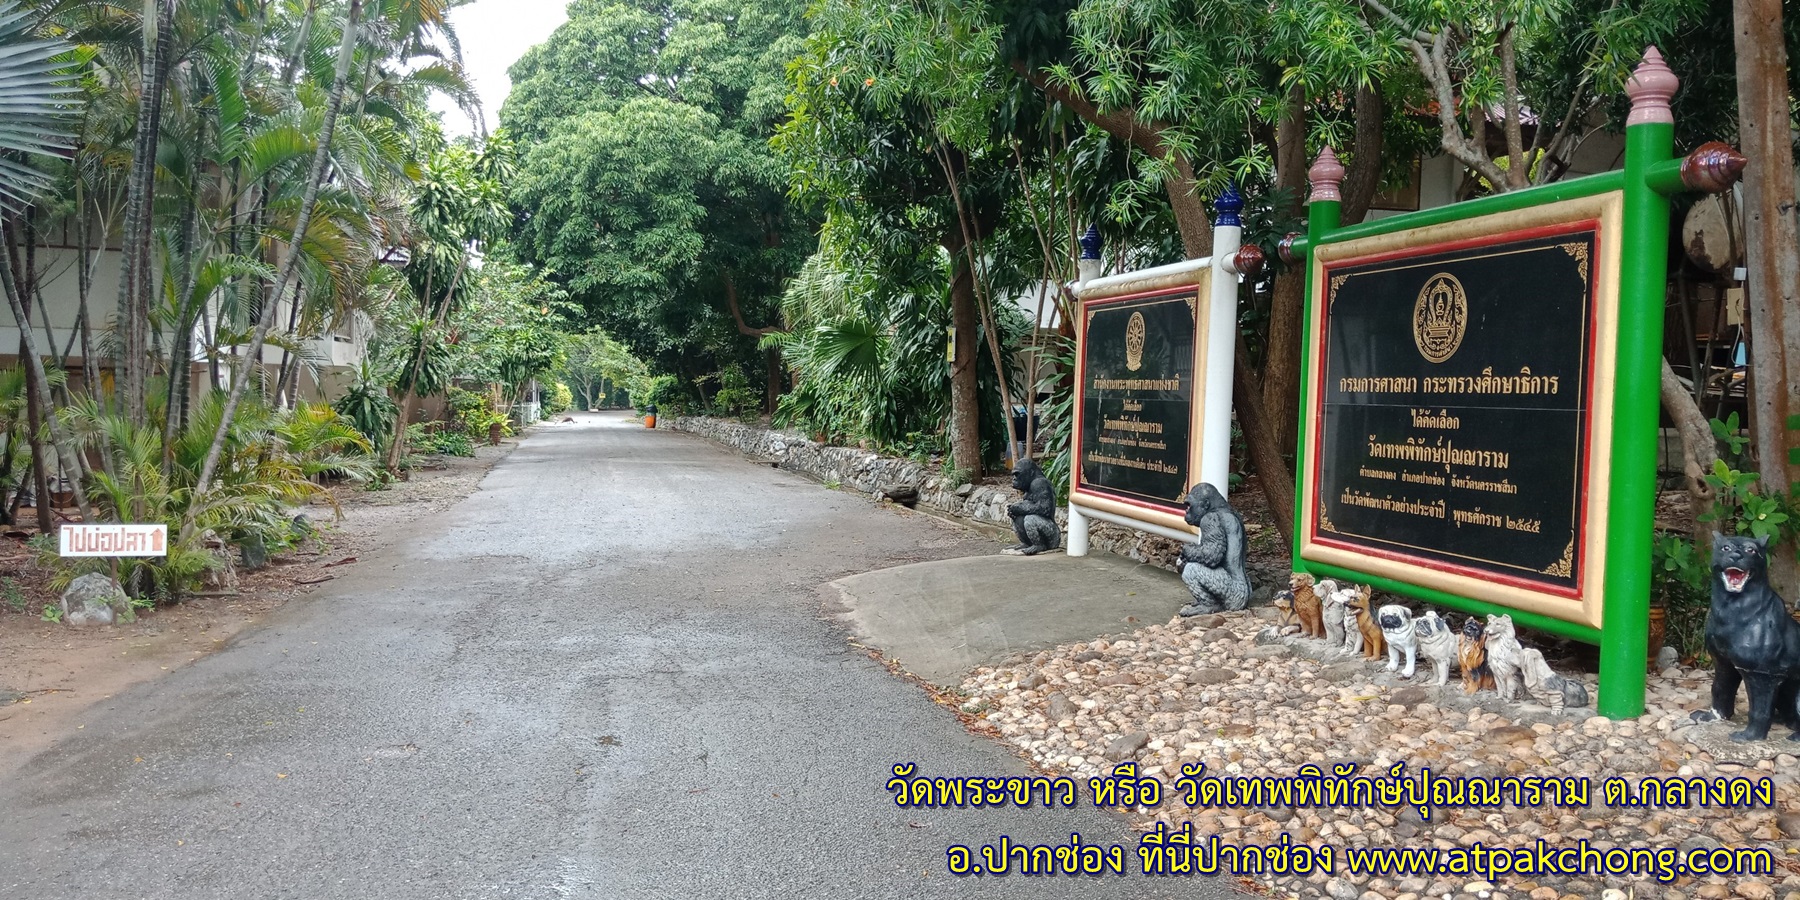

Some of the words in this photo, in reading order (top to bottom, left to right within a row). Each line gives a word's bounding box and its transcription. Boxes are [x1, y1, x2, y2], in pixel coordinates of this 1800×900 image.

[1339, 375, 1418, 394] กรมการศาสนา
[1423, 365, 1559, 395] กระทรวงศึกษาธิการ
[1411, 408, 1460, 430] ได้คัดเลือก
[1368, 434, 1509, 474] วัดเทพพิทักษ์ปุณณาราม
[1359, 465, 1397, 481] ตำบลกลางดง
[1401, 469, 1445, 487] อำเภอปากช่อง
[1451, 474, 1518, 495] จังหวัดนครราชสีมา
[1341, 487, 1445, 519] เป็นวัดพัฒนาตัวอย่างประจำปี
[1453, 507, 1502, 529] พุทธศักราช
[1506, 515, 1541, 534] ๒๕๔๕
[63, 527, 147, 553] ไปบ่อปลา
